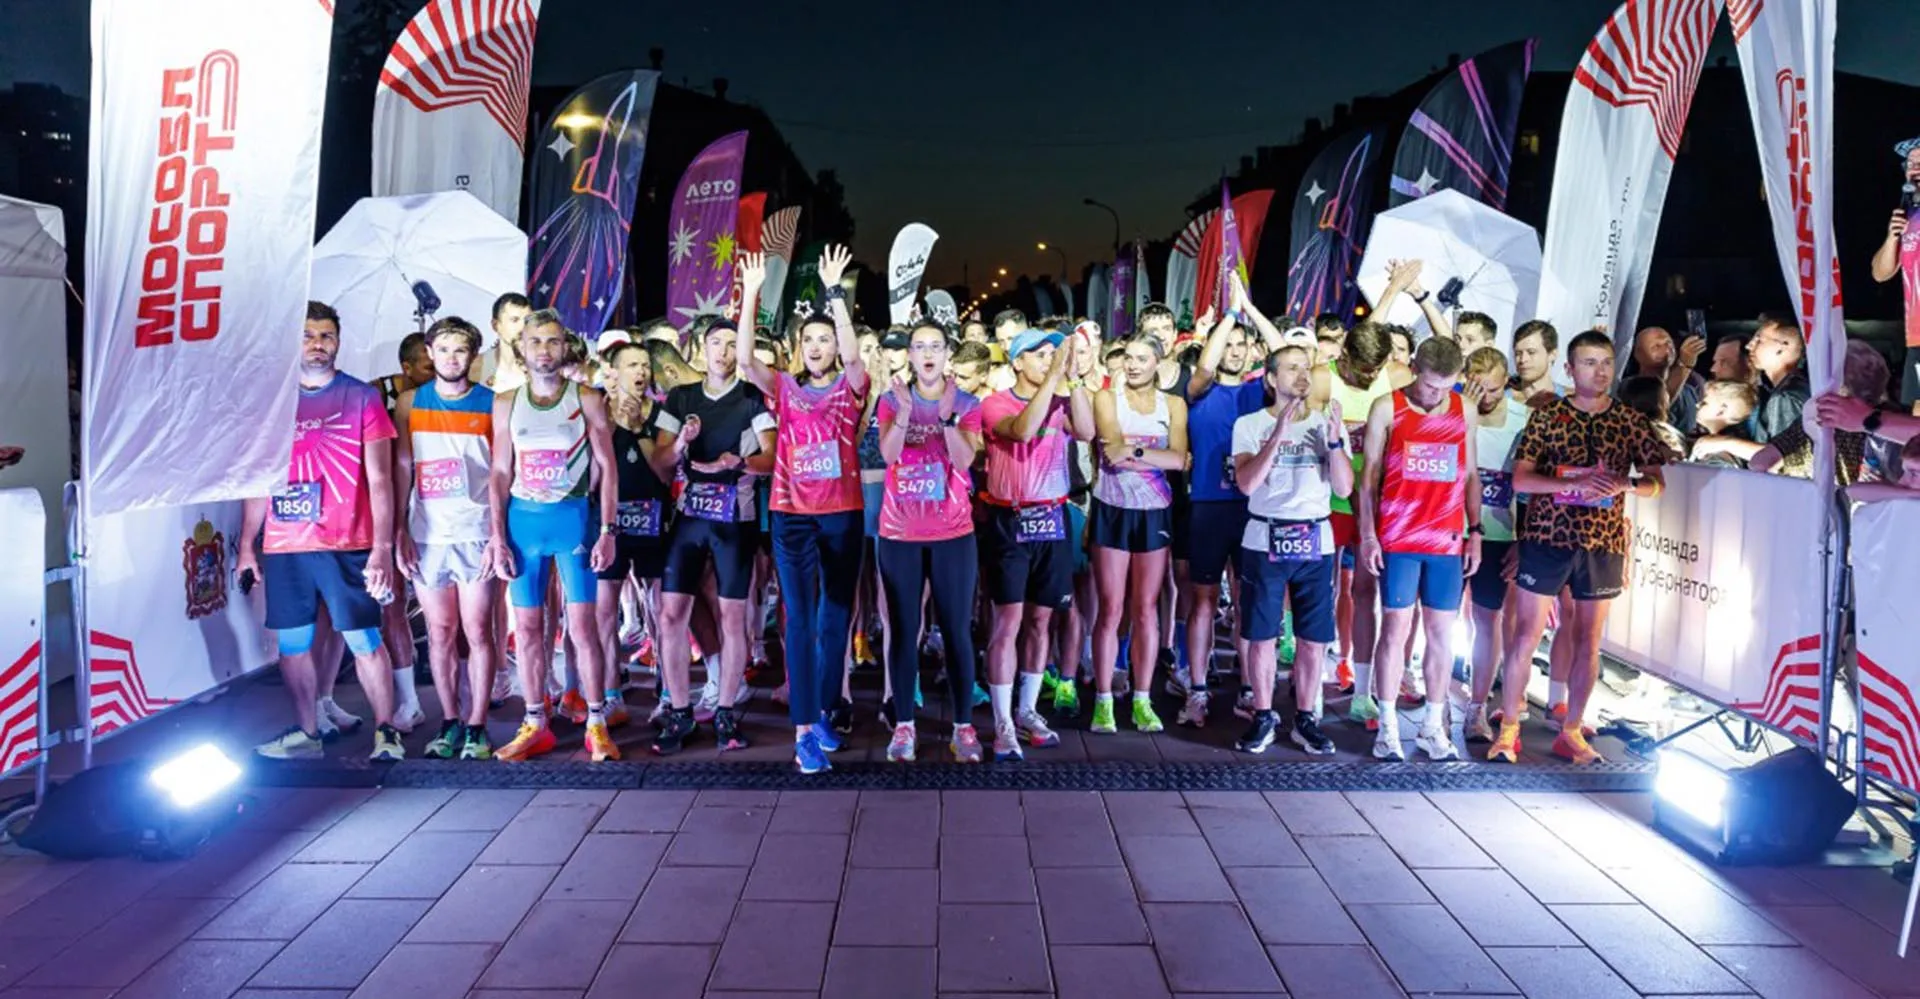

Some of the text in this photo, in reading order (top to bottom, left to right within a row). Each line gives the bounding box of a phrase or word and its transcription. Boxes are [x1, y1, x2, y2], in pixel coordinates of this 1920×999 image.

[135, 66, 196, 348] МОСОБЛ
[179, 122, 236, 342] СПОРТ
[524, 466, 565, 481] 5407
[792, 457, 833, 475] 5480
[1406, 457, 1449, 474] 5055
[422, 476, 463, 491] 5268
[897, 479, 936, 494] 5479
[276, 500, 312, 515] 1850
[691, 496, 724, 513] 1122
[1021, 519, 1057, 534] 1522
[1274, 540, 1313, 554] 1055
[1635, 526, 1699, 564] Команда
